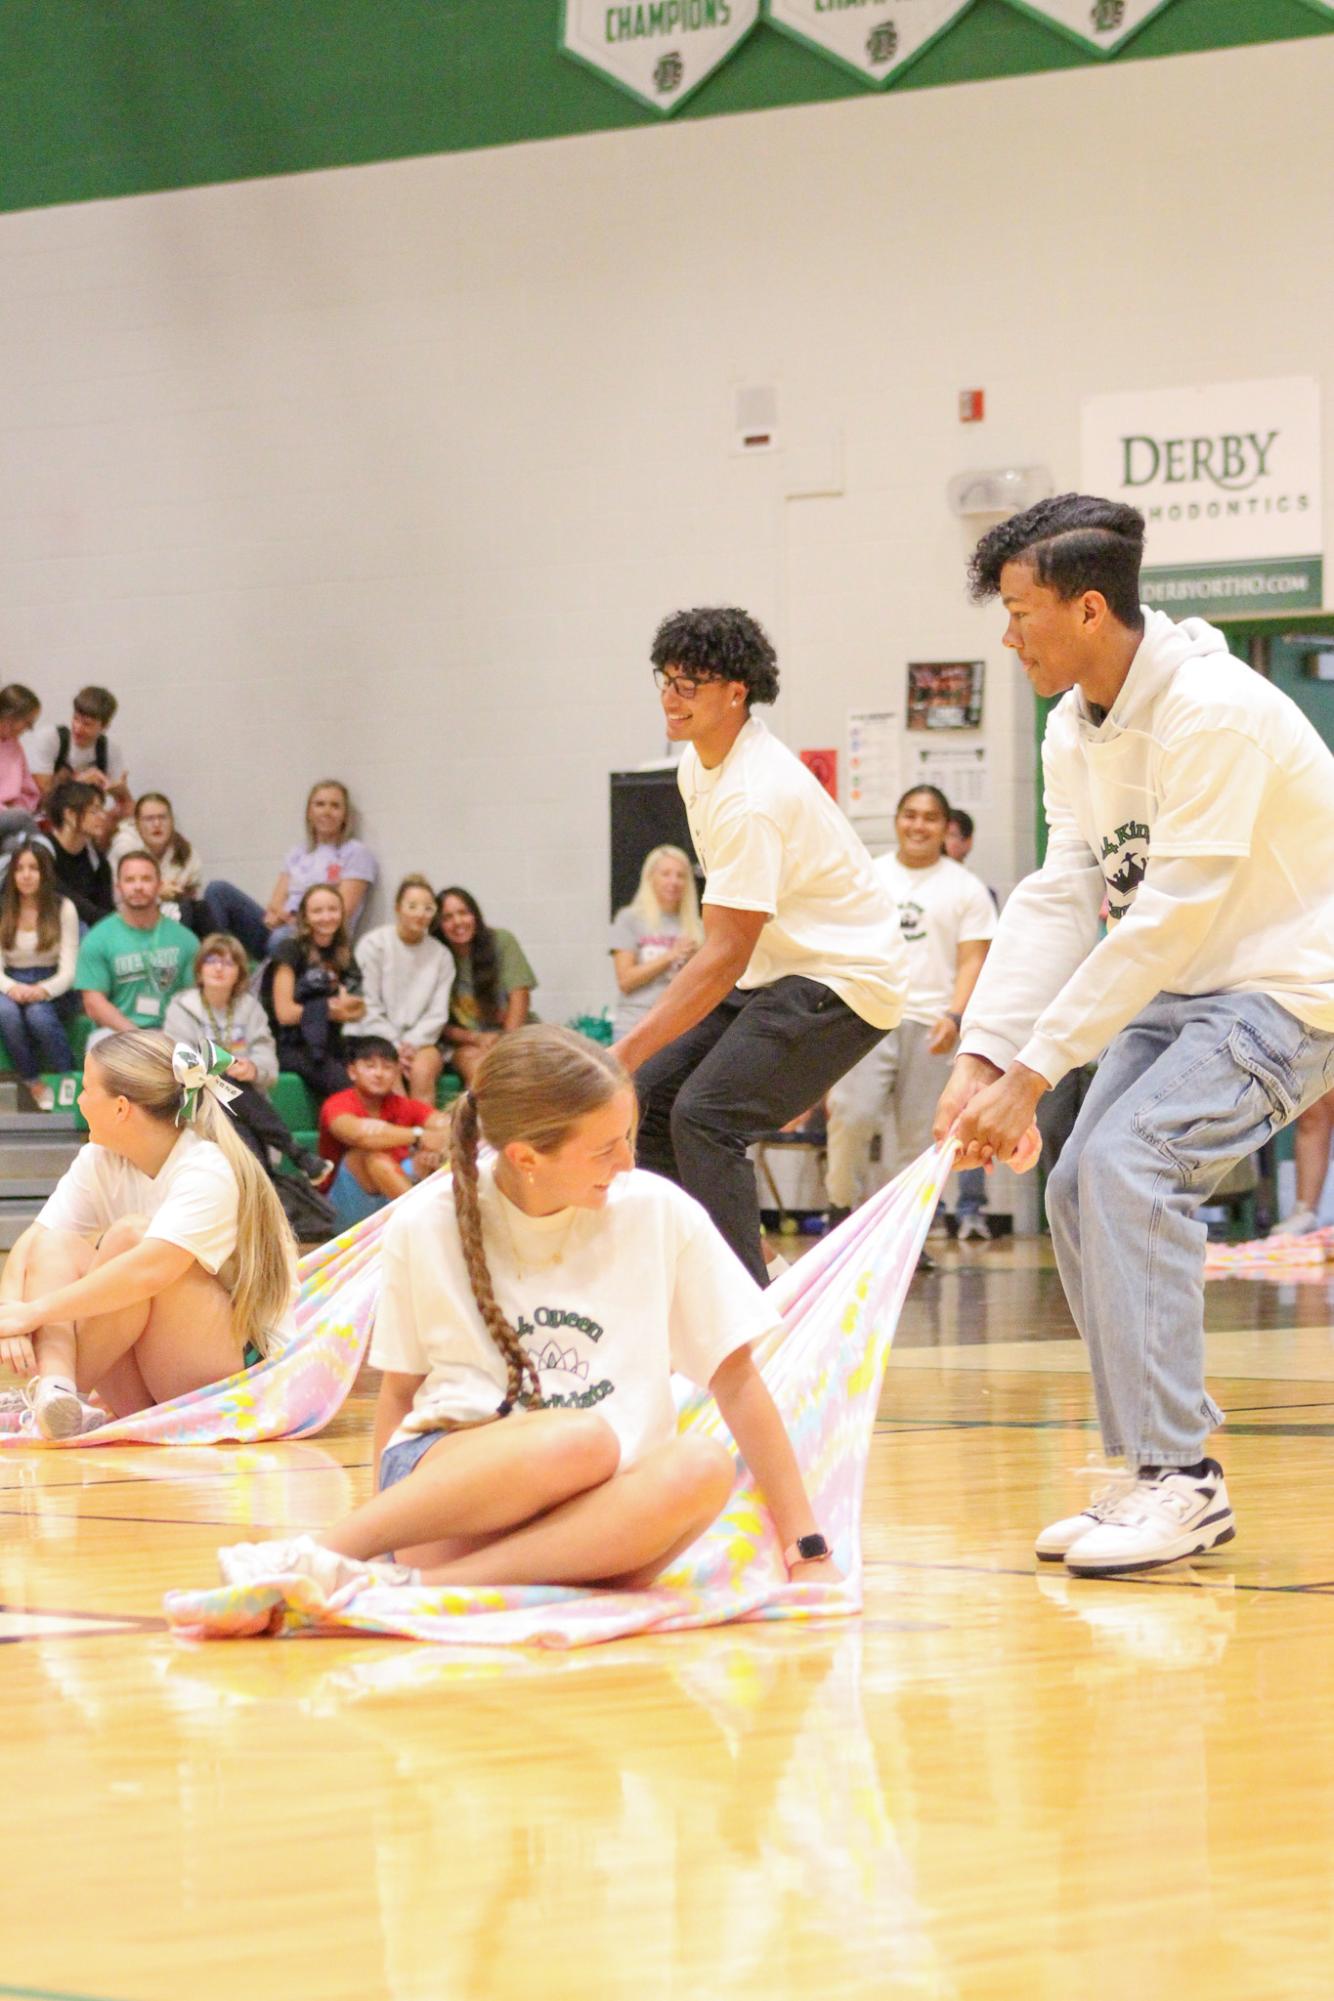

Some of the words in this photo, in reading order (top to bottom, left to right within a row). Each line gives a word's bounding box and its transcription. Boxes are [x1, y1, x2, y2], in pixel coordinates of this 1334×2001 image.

[605, 0, 731, 43] CHAMPIONS
[1122, 431, 1277, 490] DERBY
[1138, 495, 1307, 520] HODONTICS
[1114, 820, 1150, 846] Kin
[534, 1306, 604, 1343] Queen
